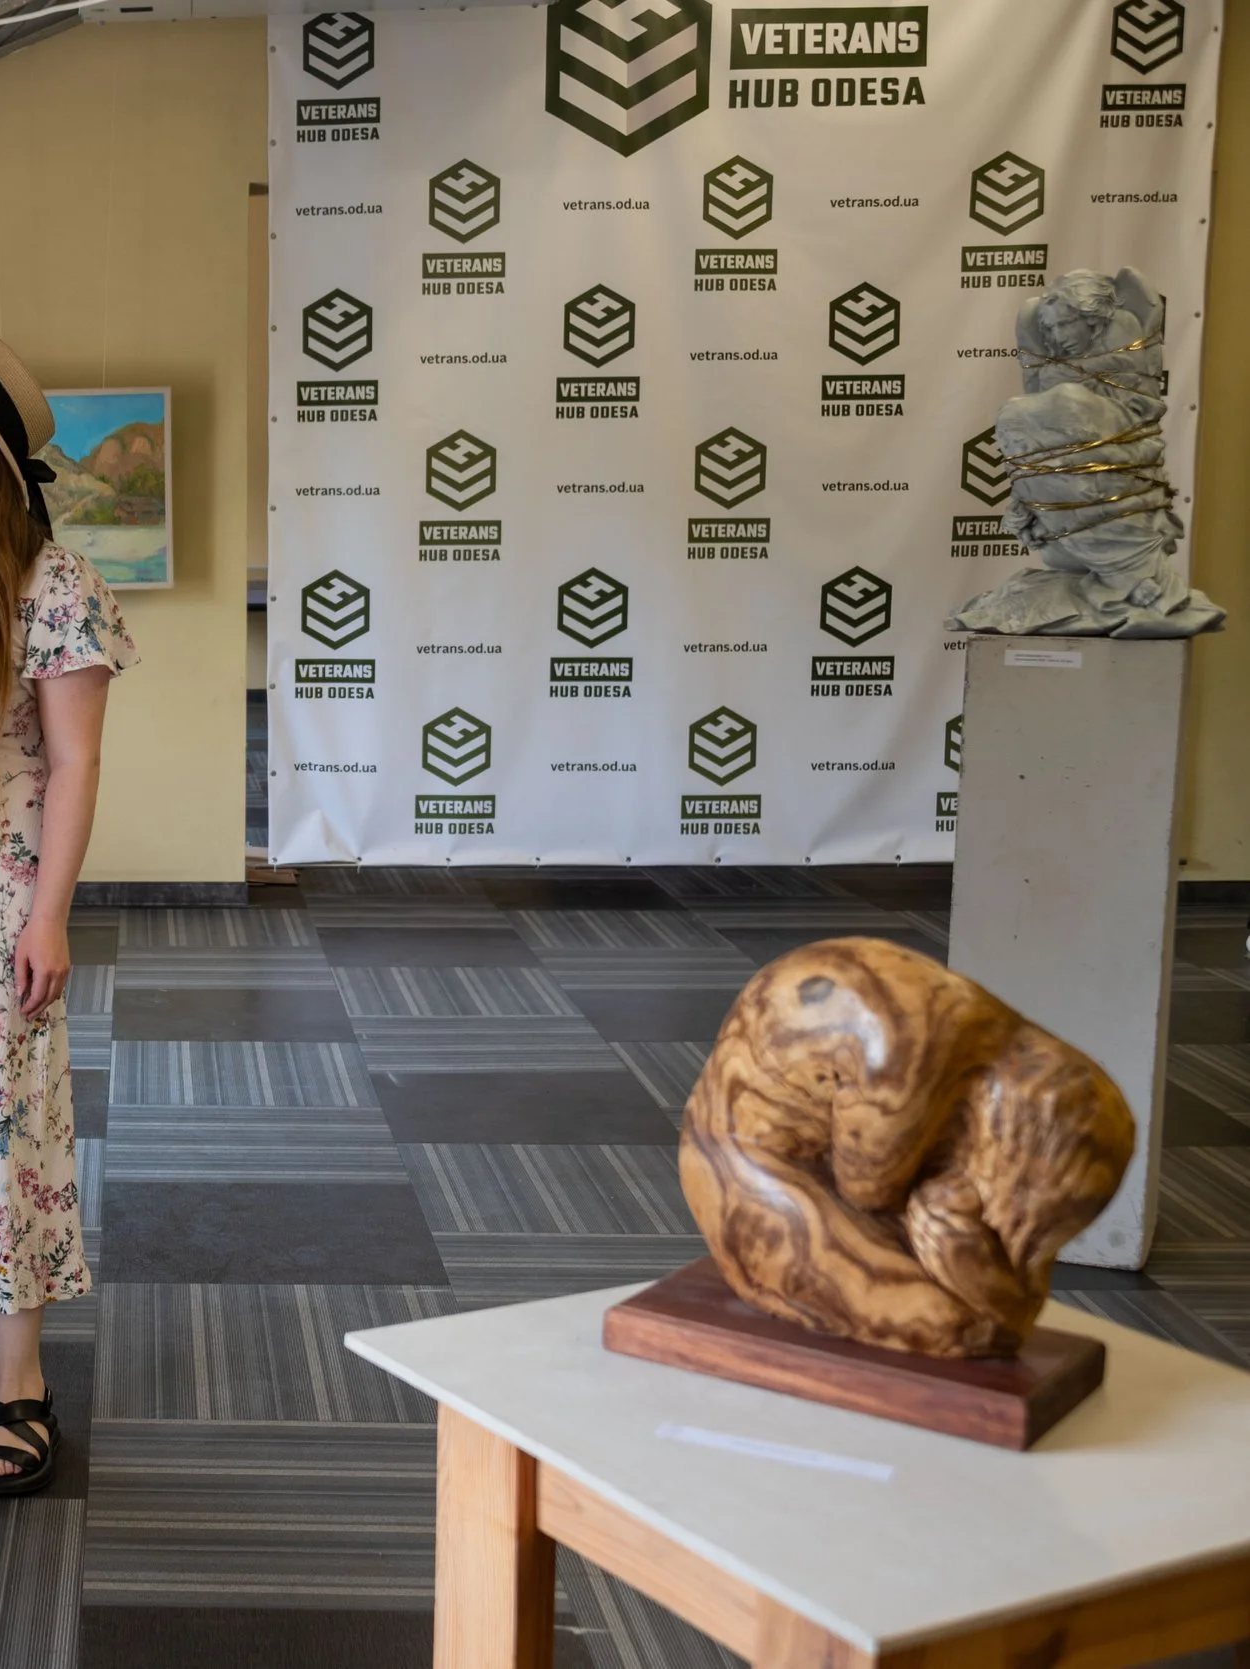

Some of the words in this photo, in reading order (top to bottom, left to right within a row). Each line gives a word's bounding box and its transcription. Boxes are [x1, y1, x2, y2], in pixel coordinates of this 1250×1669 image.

[739, 21, 920, 55] VETERANS
[728, 78, 799, 109] HUB
[811, 76, 926, 107] ODESA
[1105, 89, 1183, 106] VETERANS
[300, 103, 377, 120] VETERANS
[1099, 114, 1131, 129] HUB
[1135, 113, 1183, 128] ODESA
[296, 129, 327, 143] HUB
[331, 126, 380, 142] ODESA
[562, 198, 650, 211] vetrans.od.ua
[830, 195, 919, 208] vetrans.od.ua
[1090, 190, 1178, 204] vetrans.od.ua
[295, 202, 383, 217] vetrans.od.ua
[425, 257, 503, 274] VETERANS
[699, 254, 775, 269] VETERANS
[965, 250, 1045, 267] VETERANS
[421, 282, 452, 296] HUB
[456, 281, 505, 295] ODESA
[694, 278, 725, 292] HUB
[729, 278, 777, 292] ODESA
[960, 275, 992, 289] HUB
[996, 273, 1045, 288] ODESA
[420, 351, 508, 365] vetrans.od.ua
[689, 348, 778, 361] vetrans.od.ua
[956, 346, 1018, 359] vetrans.o
[300, 385, 375, 401] VETERANS
[559, 381, 637, 398] VETERANS
[825, 380, 902, 395] VETERANS
[296, 409, 326, 423] HUB
[330, 408, 378, 422] ODESA
[555, 406, 586, 420] HUB
[590, 405, 639, 419] ODESA
[821, 404, 851, 417] HUB
[855, 403, 904, 417] ODESA
[295, 484, 381, 497] vetrans.od.ua
[556, 481, 645, 494] vetrans.od.ua
[821, 479, 909, 492] vetrans.od.ua
[422, 525, 499, 541] VETERANS
[691, 523, 767, 538] VETERANS
[955, 520, 1008, 537] VETER
[418, 549, 448, 562] HUB
[452, 548, 501, 562] ODESA
[687, 546, 716, 560] HUB
[720, 546, 769, 560] ODESA
[950, 544, 979, 558] HUB
[983, 543, 1030, 557] ODESA
[416, 642, 502, 654] vetrans.od.ua
[683, 640, 768, 653] vetrans.od.ua
[298, 664, 373, 679] VETERANS
[553, 662, 630, 677] VETERANS
[815, 661, 891, 676] VETERANS
[294, 686, 323, 699] HUB
[327, 686, 375, 699] ODESA
[549, 685, 579, 698] HUB
[583, 685, 632, 698] ODESA
[810, 684, 841, 697] HUB
[844, 683, 893, 697] ODESA
[293, 761, 377, 774] vetrans.od.ua
[550, 760, 637, 772] vetrans.od.ua
[810, 759, 896, 771] vetrans.od.ua
[418, 800, 493, 815] VETERANS
[684, 799, 758, 814] VETERANS
[414, 822, 444, 835] HUB
[448, 822, 495, 835] ODESA
[680, 822, 709, 835] HUB
[713, 822, 761, 835] ODESA
[934, 818, 957, 833] HU
